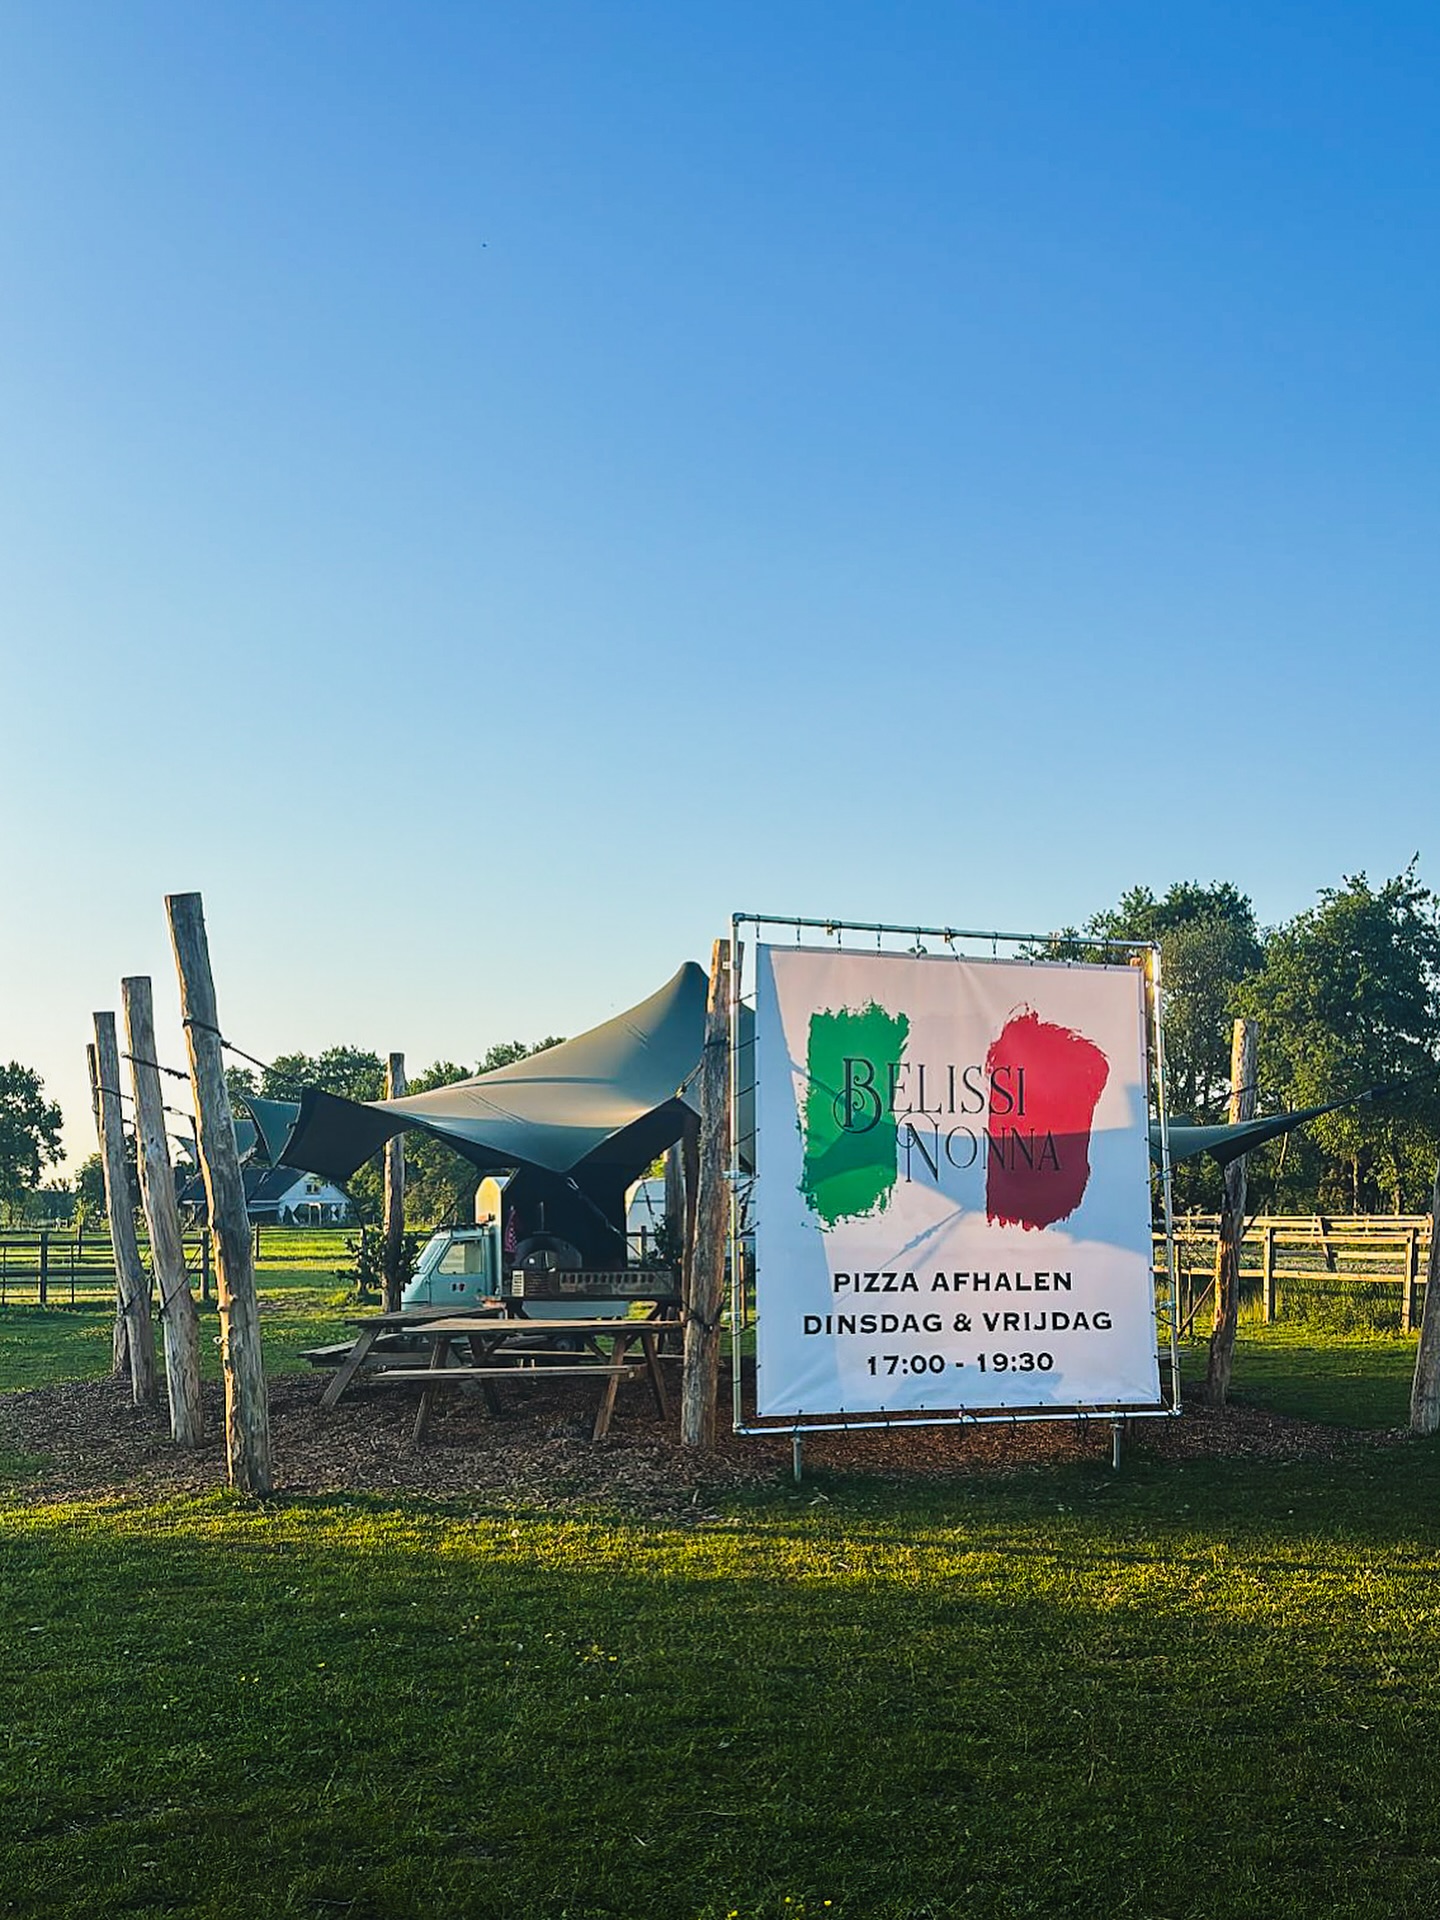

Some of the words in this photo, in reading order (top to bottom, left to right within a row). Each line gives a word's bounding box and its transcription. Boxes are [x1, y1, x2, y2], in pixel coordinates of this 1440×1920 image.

[833, 1057, 1026, 1134] BELISSI
[896, 1111, 1060, 1183] NONNA
[833, 1272, 920, 1293] PIZZA
[931, 1271, 1073, 1293] AFHALEN
[803, 1313, 943, 1335] DINSDAG
[953, 1313, 972, 1333] &
[983, 1311, 1113, 1332] VRIJDAG
[867, 1354, 945, 1376] 17:00
[977, 1352, 1054, 1373] 19:30
